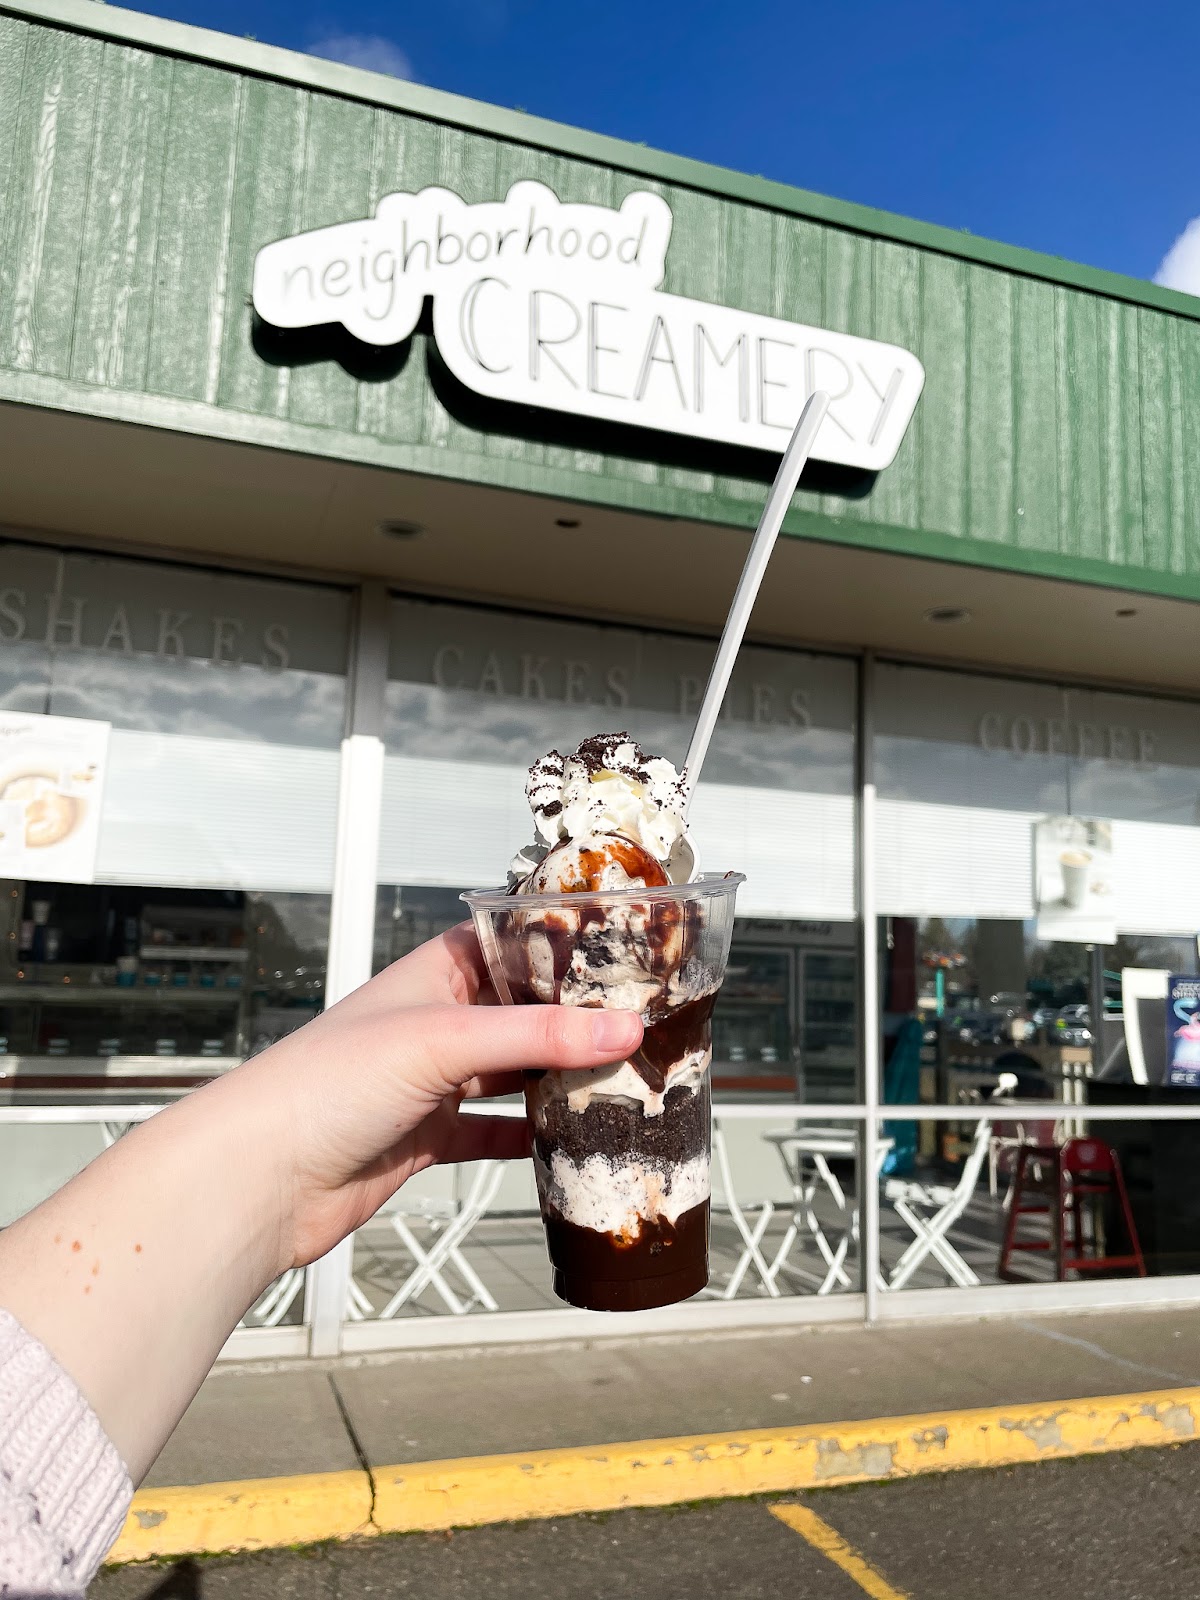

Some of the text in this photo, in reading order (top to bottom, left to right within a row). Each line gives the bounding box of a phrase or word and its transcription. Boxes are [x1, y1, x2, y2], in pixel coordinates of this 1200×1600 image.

[281, 207, 649, 321] neighborhood
[460, 277, 903, 448] CREAMERY
[0, 588, 291, 671] SHAKES
[432, 647, 631, 710] CAKES
[979, 713, 1158, 769] COFFEE
